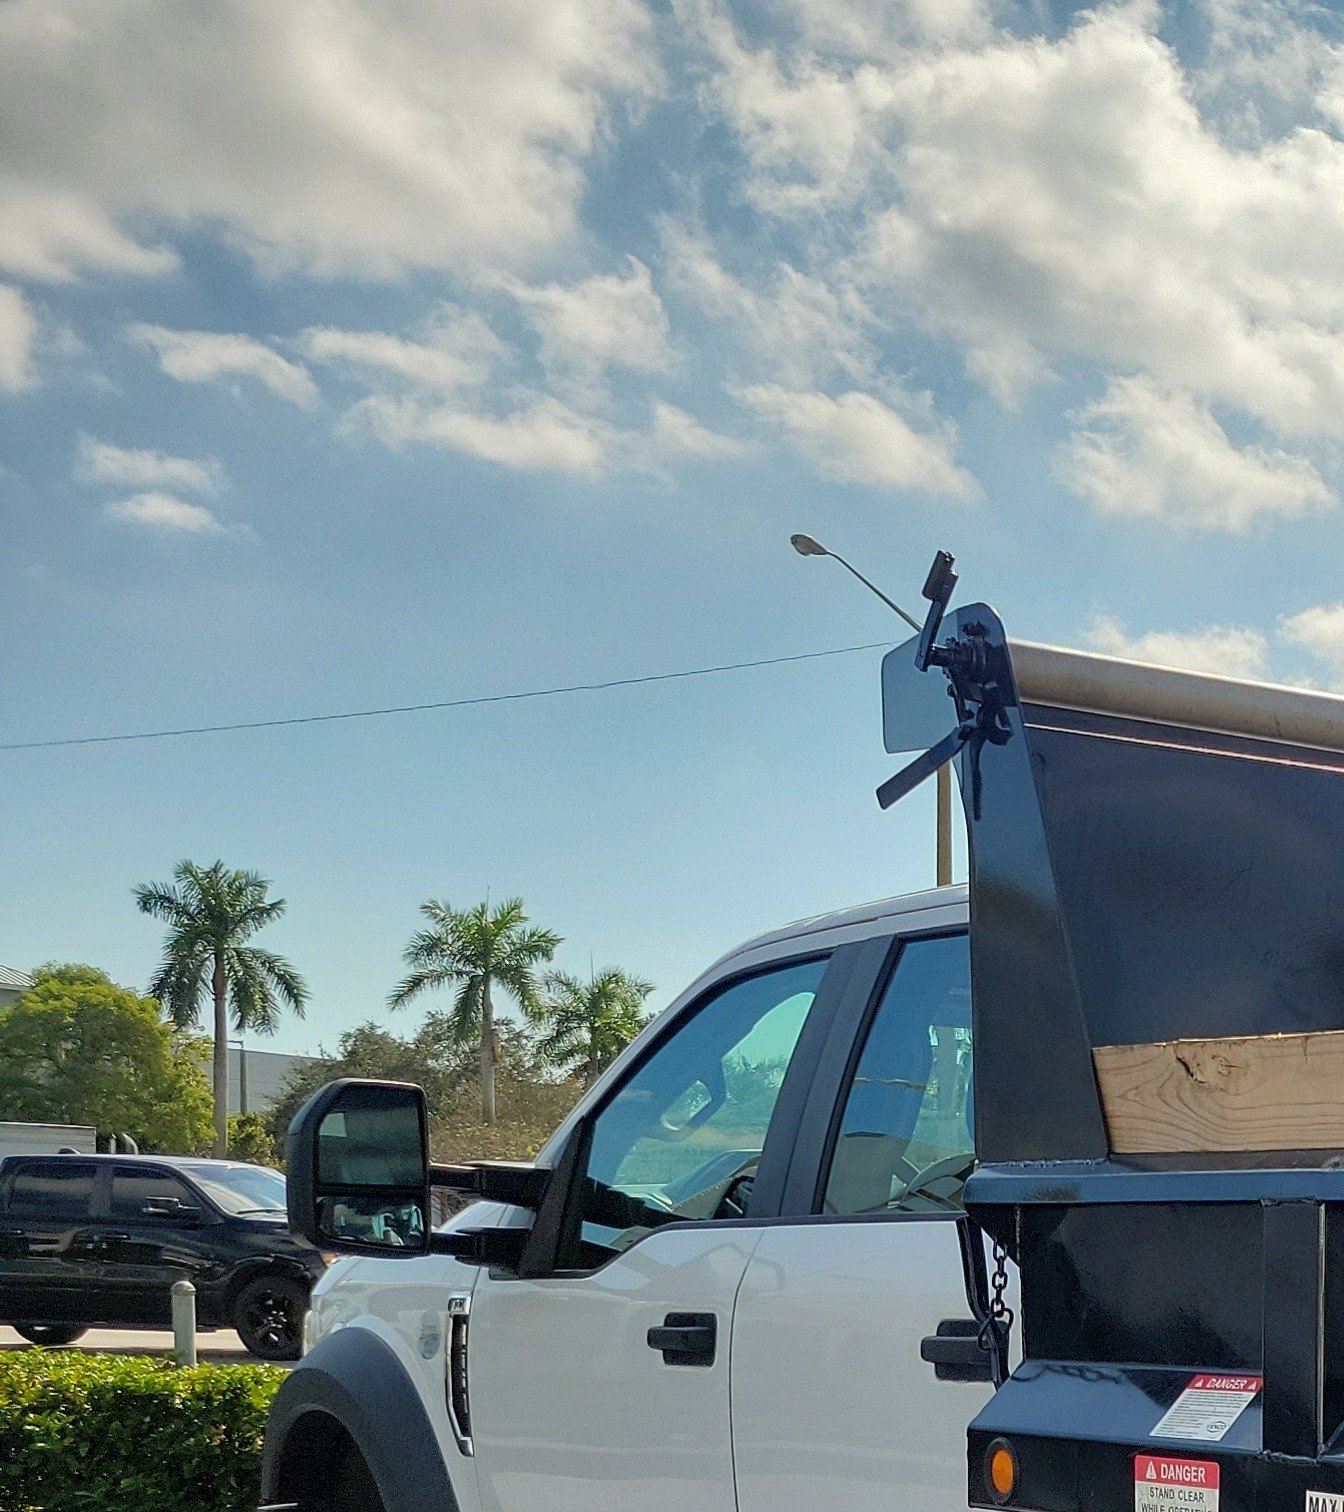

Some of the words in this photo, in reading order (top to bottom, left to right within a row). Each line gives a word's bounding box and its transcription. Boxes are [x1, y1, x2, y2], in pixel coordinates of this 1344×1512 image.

[1206, 1378, 1247, 1390] DANGER
[1161, 1463, 1206, 1483] DANGER
[1149, 1486, 1175, 1500] STAND
[1178, 1489, 1205, 1503] CLEAR
